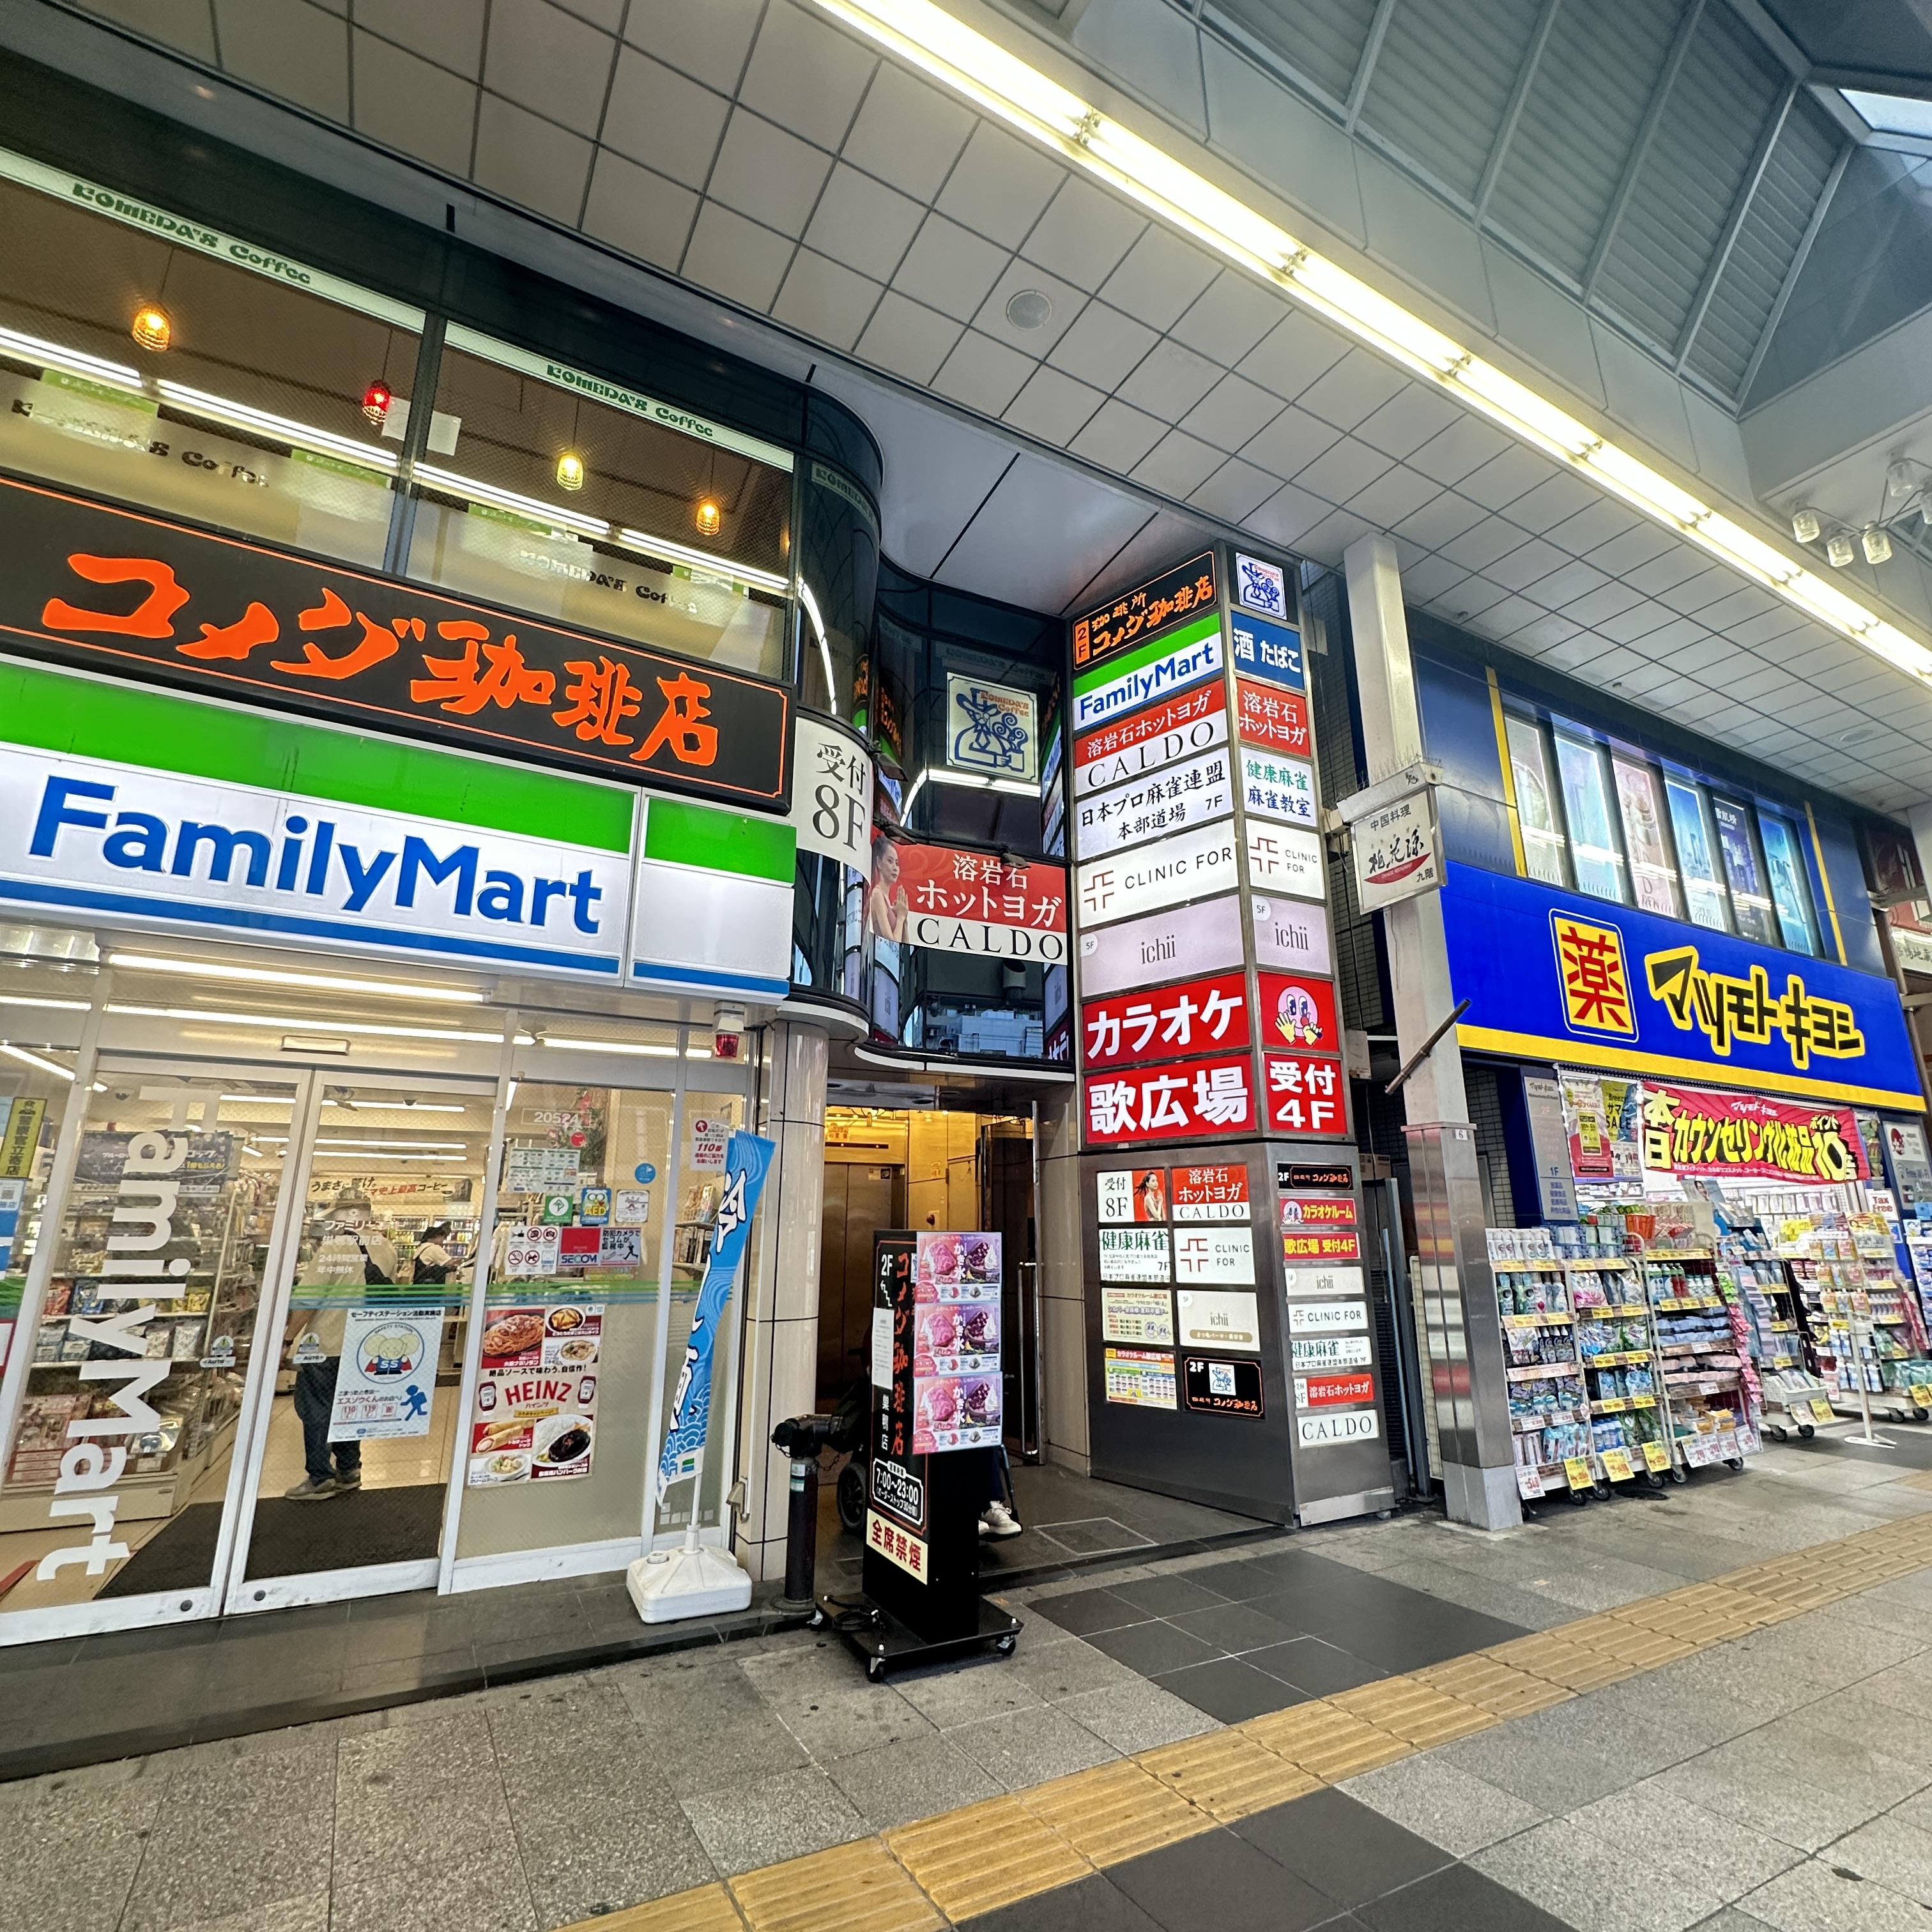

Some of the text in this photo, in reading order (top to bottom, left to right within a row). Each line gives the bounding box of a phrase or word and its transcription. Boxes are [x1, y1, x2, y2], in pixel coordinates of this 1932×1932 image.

[72, 183, 310, 284] KOMEDA'S Coffee
[547, 364, 713, 438] KOMEDA'S Coffee
[1092, 574, 1213, 656] コメダ珈琲店
[42, 553, 718, 766] コメダ珈琲店
[1234, 627, 1302, 674] 酒 たばこ
[1080, 642, 1214, 721] FamilyMart
[998, 703, 1029, 717] Coffee
[1243, 689, 1298, 724] 溶岩石
[1087, 689, 1212, 759] 溶岩石ホットヨガ
[1239, 715, 1307, 746] ホットヨガ
[816, 742, 866, 795] 受付
[1087, 721, 1215, 788] CALDO
[1246, 759, 1309, 792] 健康麻雀
[1080, 760, 1226, 827] 日本プロ麻雀連盟
[1248, 786, 1311, 818] 麻雀教室
[812, 784, 866, 852] 8F
[1117, 795, 1223, 841] 本部道場 7F
[1370, 804, 1411, 831] 中国料理
[29, 774, 602, 935] FamilyMart
[1124, 847, 1232, 890] CLINIC FOR
[1284, 849, 1318, 864] CLINIC
[1287, 862, 1305, 874] FOR
[952, 854, 1029, 890] 溶岩石
[1416, 867, 1434, 883] 九階
[916, 879, 1062, 928] ホットヨガ
[1255, 905, 1266, 914] 5F
[917, 917, 1063, 960] CALDO
[1085, 941, 1094, 951] 5F
[1140, 934, 1177, 965] ichii
[1275, 921, 1310, 951] ichii
[1561, 926, 1628, 1027] 薬
[1644, 946, 1864, 1070] マツモトキヨシ
[1087, 989, 1243, 1060] カラオケ
[1269, 1061, 1337, 1096] 受付
[1089, 1066, 1248, 1135] 歌広場
[1275, 1099, 1335, 1130] 4F
[1607, 1103, 1629, 1116] サマー
[533, 1110, 580, 1124] 20524
[1606, 1115, 1632, 1130] SALE
[1643, 1089, 1681, 1169] 本日
[1809, 1114, 1840, 1131] ポイント
[1673, 1110, 1816, 1175] カウンセリング化粧品
[1105, 1176, 1126, 1192] 受付
[1188, 1169, 1229, 1185] 溶岩石
[1278, 1172, 1289, 1182] 2F
[1549, 1167, 1559, 1176] 1F
[1178, 1181, 1243, 1203] ホットヨガ
[1871, 1195, 1890, 1204] Tax
[584, 1206, 607, 1216] AED
[1105, 1196, 1128, 1218] 8F
[1179, 1204, 1245, 1220] CALDO
[1302, 1204, 1354, 1220] カラオケルーム
[1101, 1230, 1169, 1251] 健康麻雀
[1215, 1243, 1250, 1254] CLINIC
[1284, 1238, 1356, 1254] 歌広場 受付4F
[561, 1254, 597, 1264] SECOM
[881, 1254, 893, 1277] 2F
[953, 1242, 966, 1280] かき氷
[1157, 1261, 1170, 1271] 7F
[1216, 1257, 1236, 1267] FOR
[1307, 1310, 1362, 1322] CLINIC FOR
[36, 1085, 223, 1581] FamilyMart
[952, 1312, 965, 1354] かき氷
[1291, 1340, 1340, 1358] 健康麻雀
[380, 1360, 399, 1368] SS
[1189, 1361, 1204, 1373] 2F
[505, 1380, 572, 1406] HEINZ
[1308, 1380, 1370, 1399] 溶岩石ホットヨガ
[525, 1401, 549, 1409] ハインツ
[952, 1385, 965, 1427] かき氷
[1302, 1416, 1372, 1440] CALDO
[871, 1519, 922, 1572] 全席禁煙
